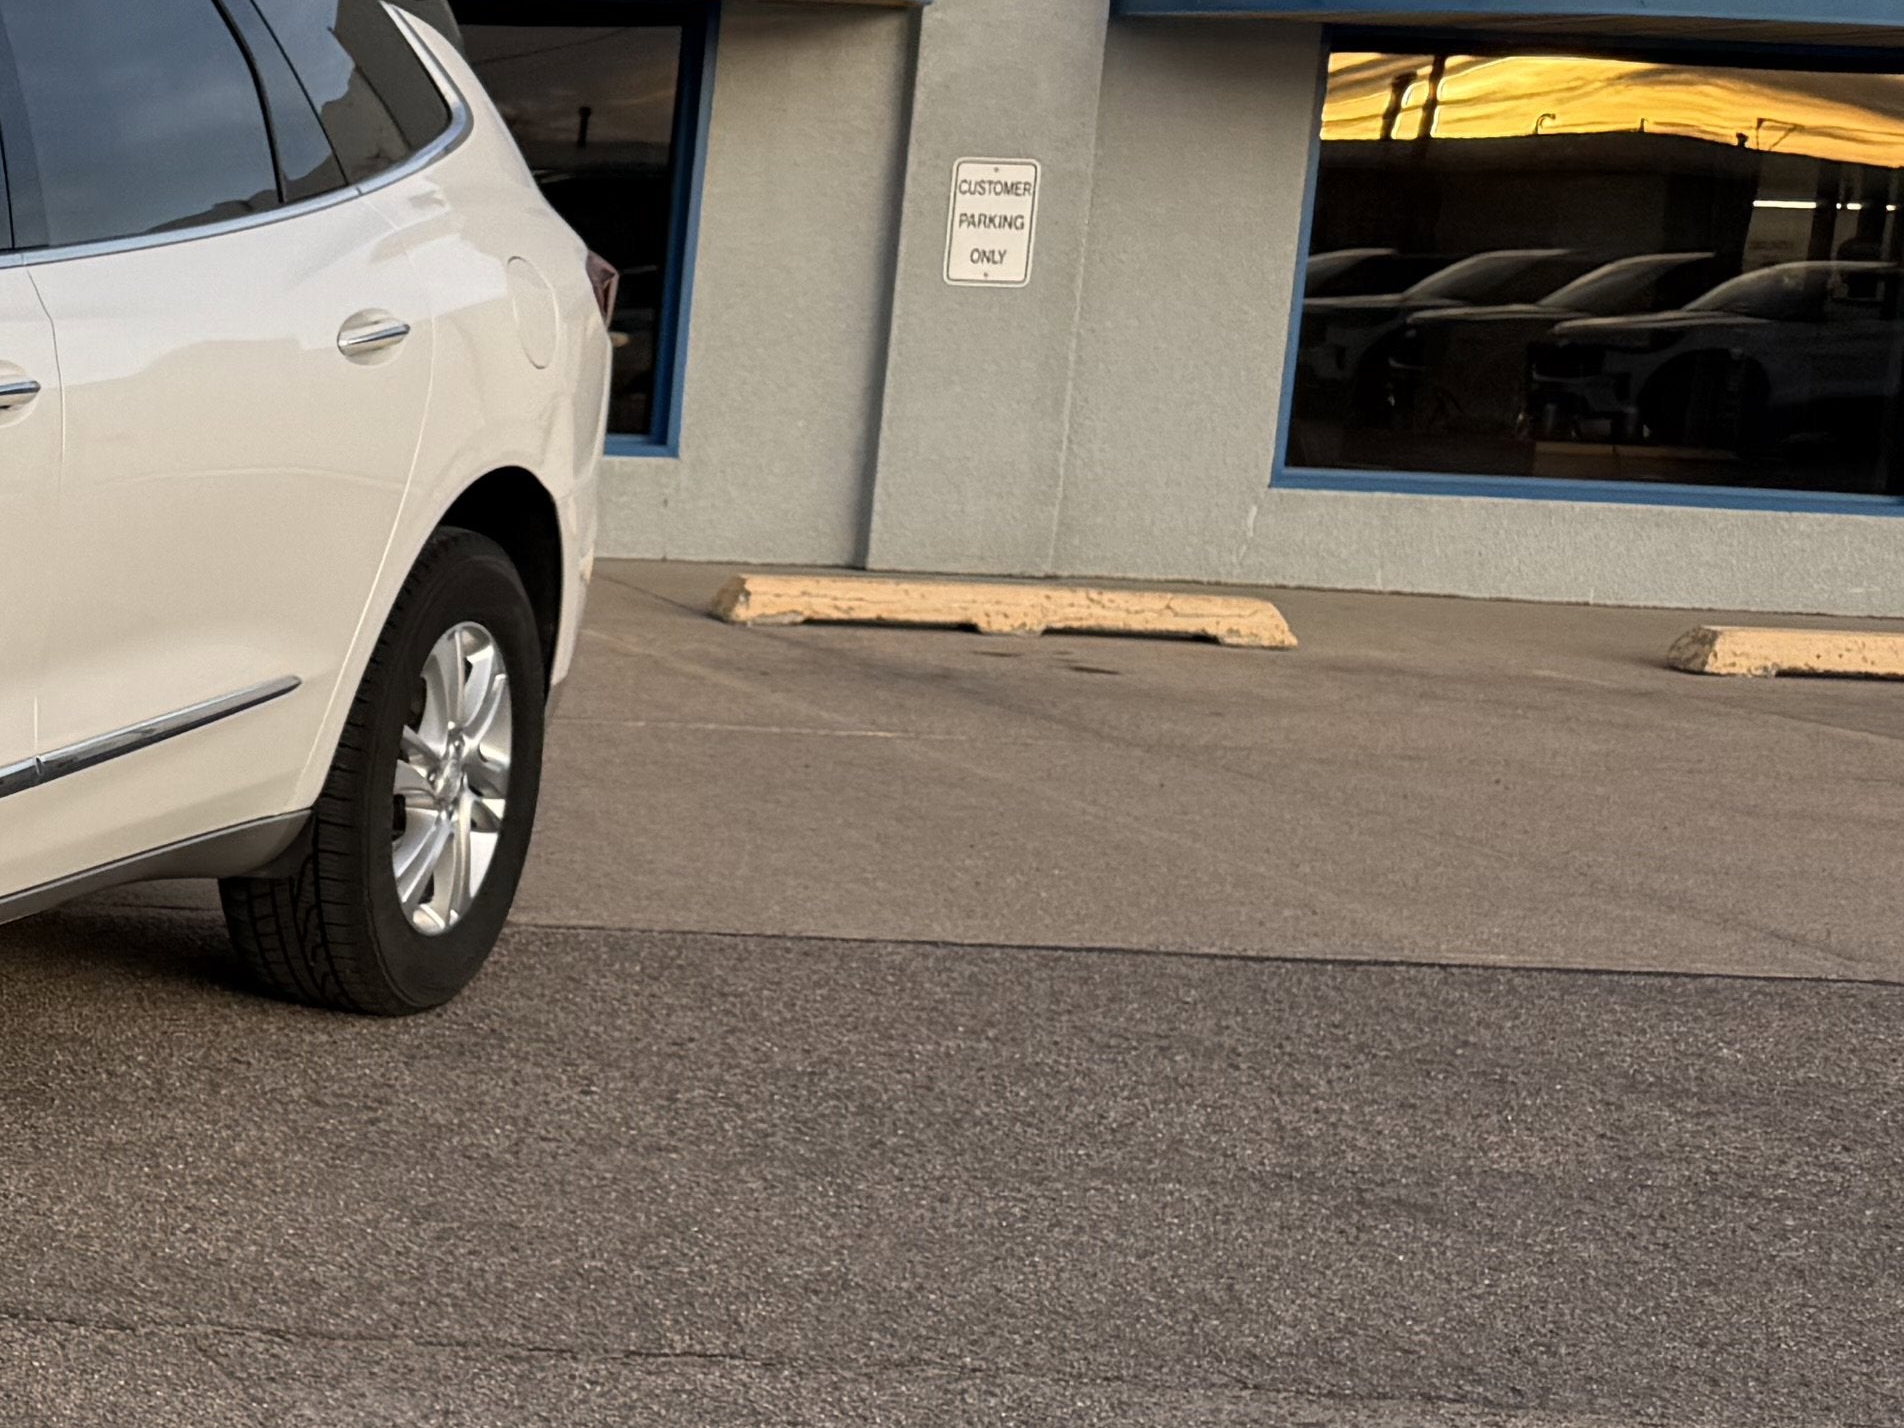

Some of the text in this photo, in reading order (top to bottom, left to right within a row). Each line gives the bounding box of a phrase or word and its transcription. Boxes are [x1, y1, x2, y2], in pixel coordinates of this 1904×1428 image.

[958, 179, 1032, 197] CUSTOMER
[958, 212, 1025, 230] PARKING
[970, 247, 1007, 265] ONLY
